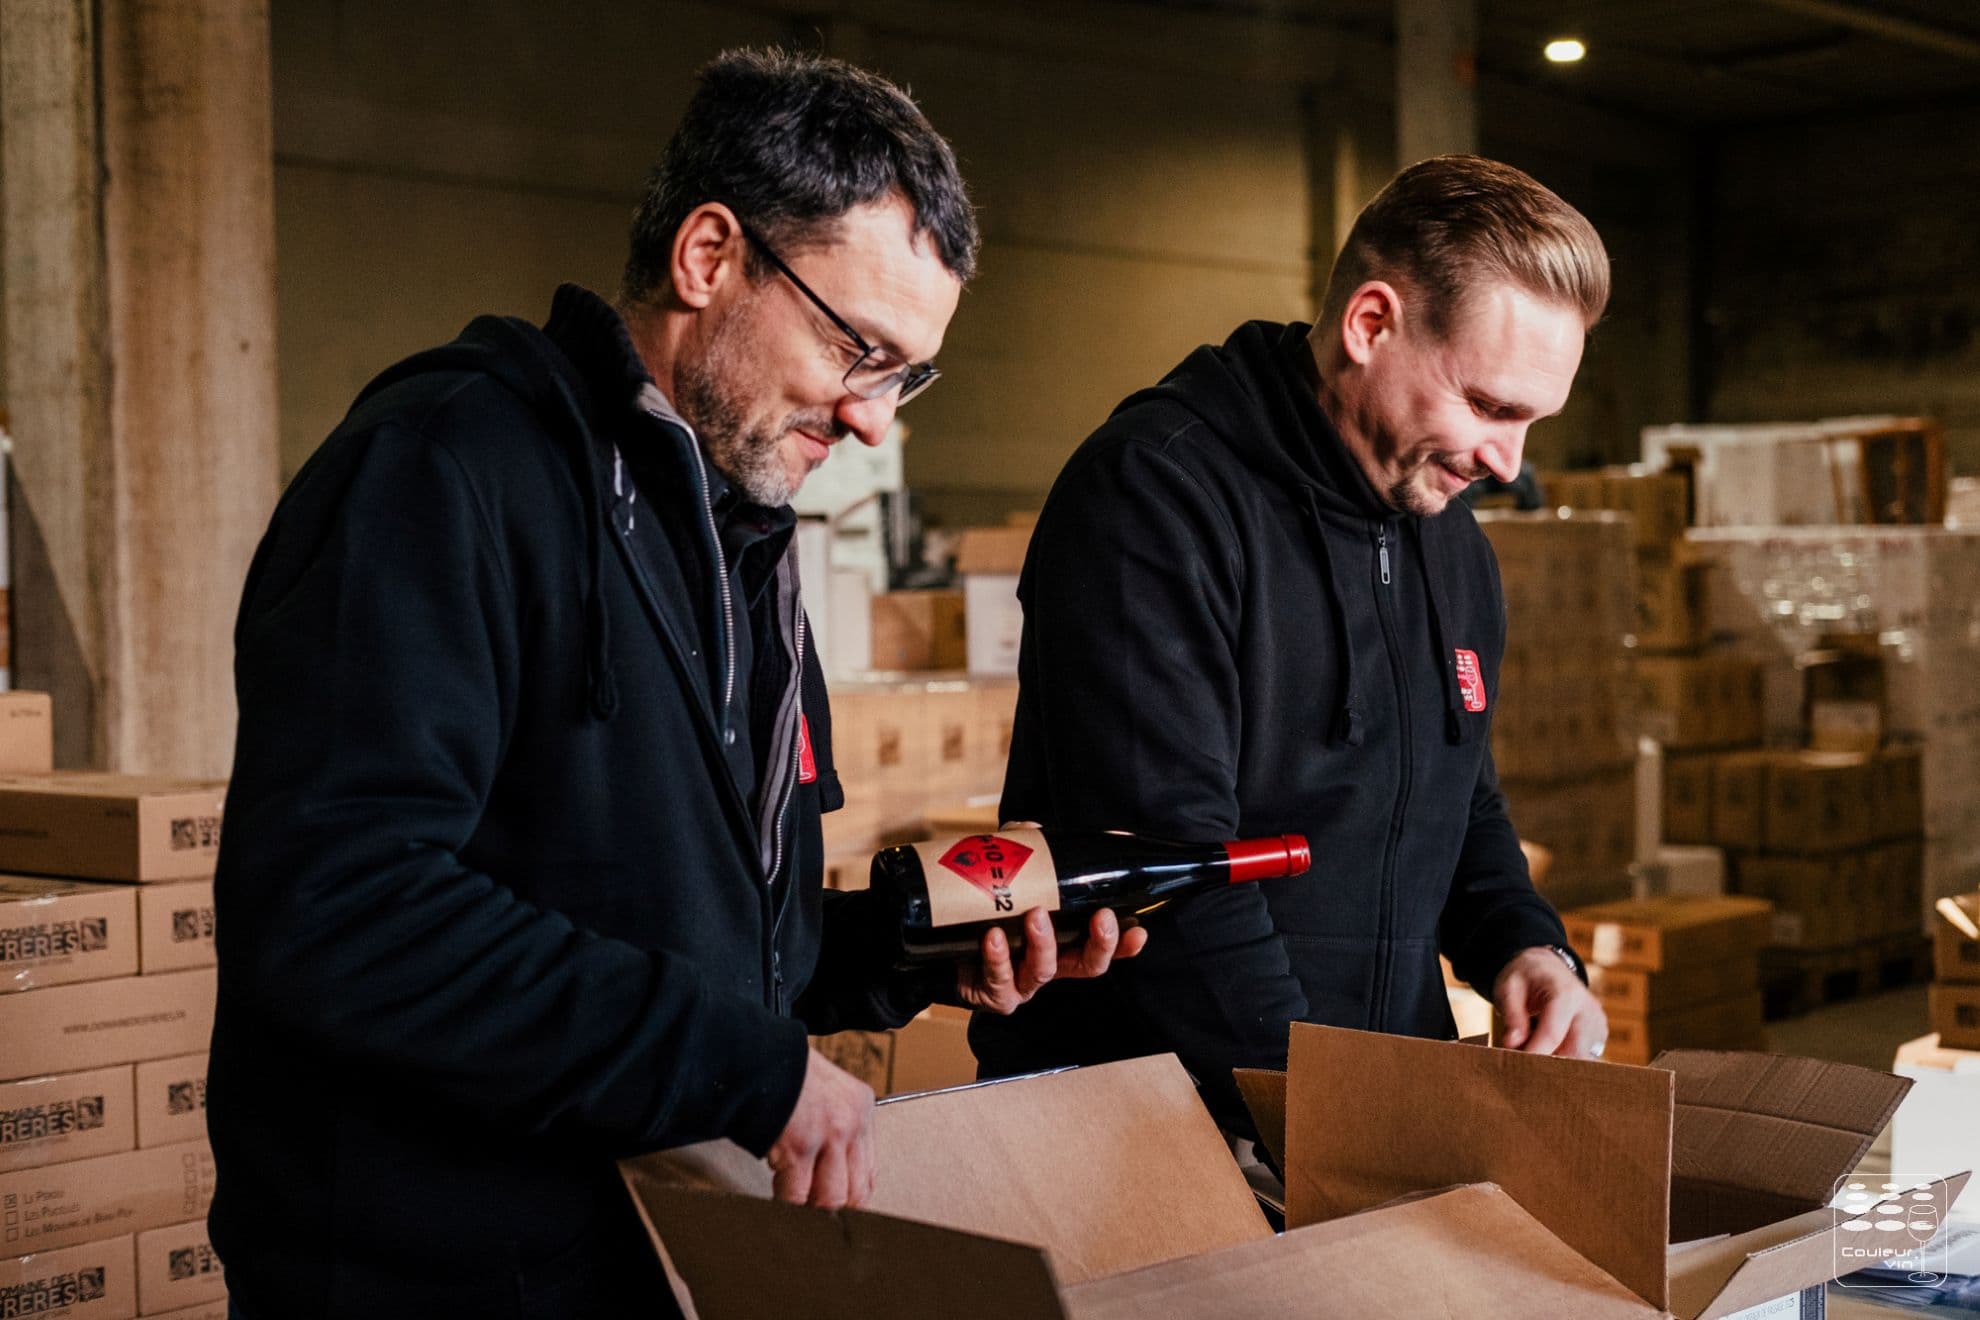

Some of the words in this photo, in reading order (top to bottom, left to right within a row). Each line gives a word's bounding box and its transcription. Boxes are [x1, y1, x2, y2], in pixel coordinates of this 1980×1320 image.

[0, 924, 46, 940] OMAINE
[0, 1104, 42, 1121] OMAINE
[0, 1111, 74, 1142] RERES
[0, 1278, 46, 1298] OMAINE
